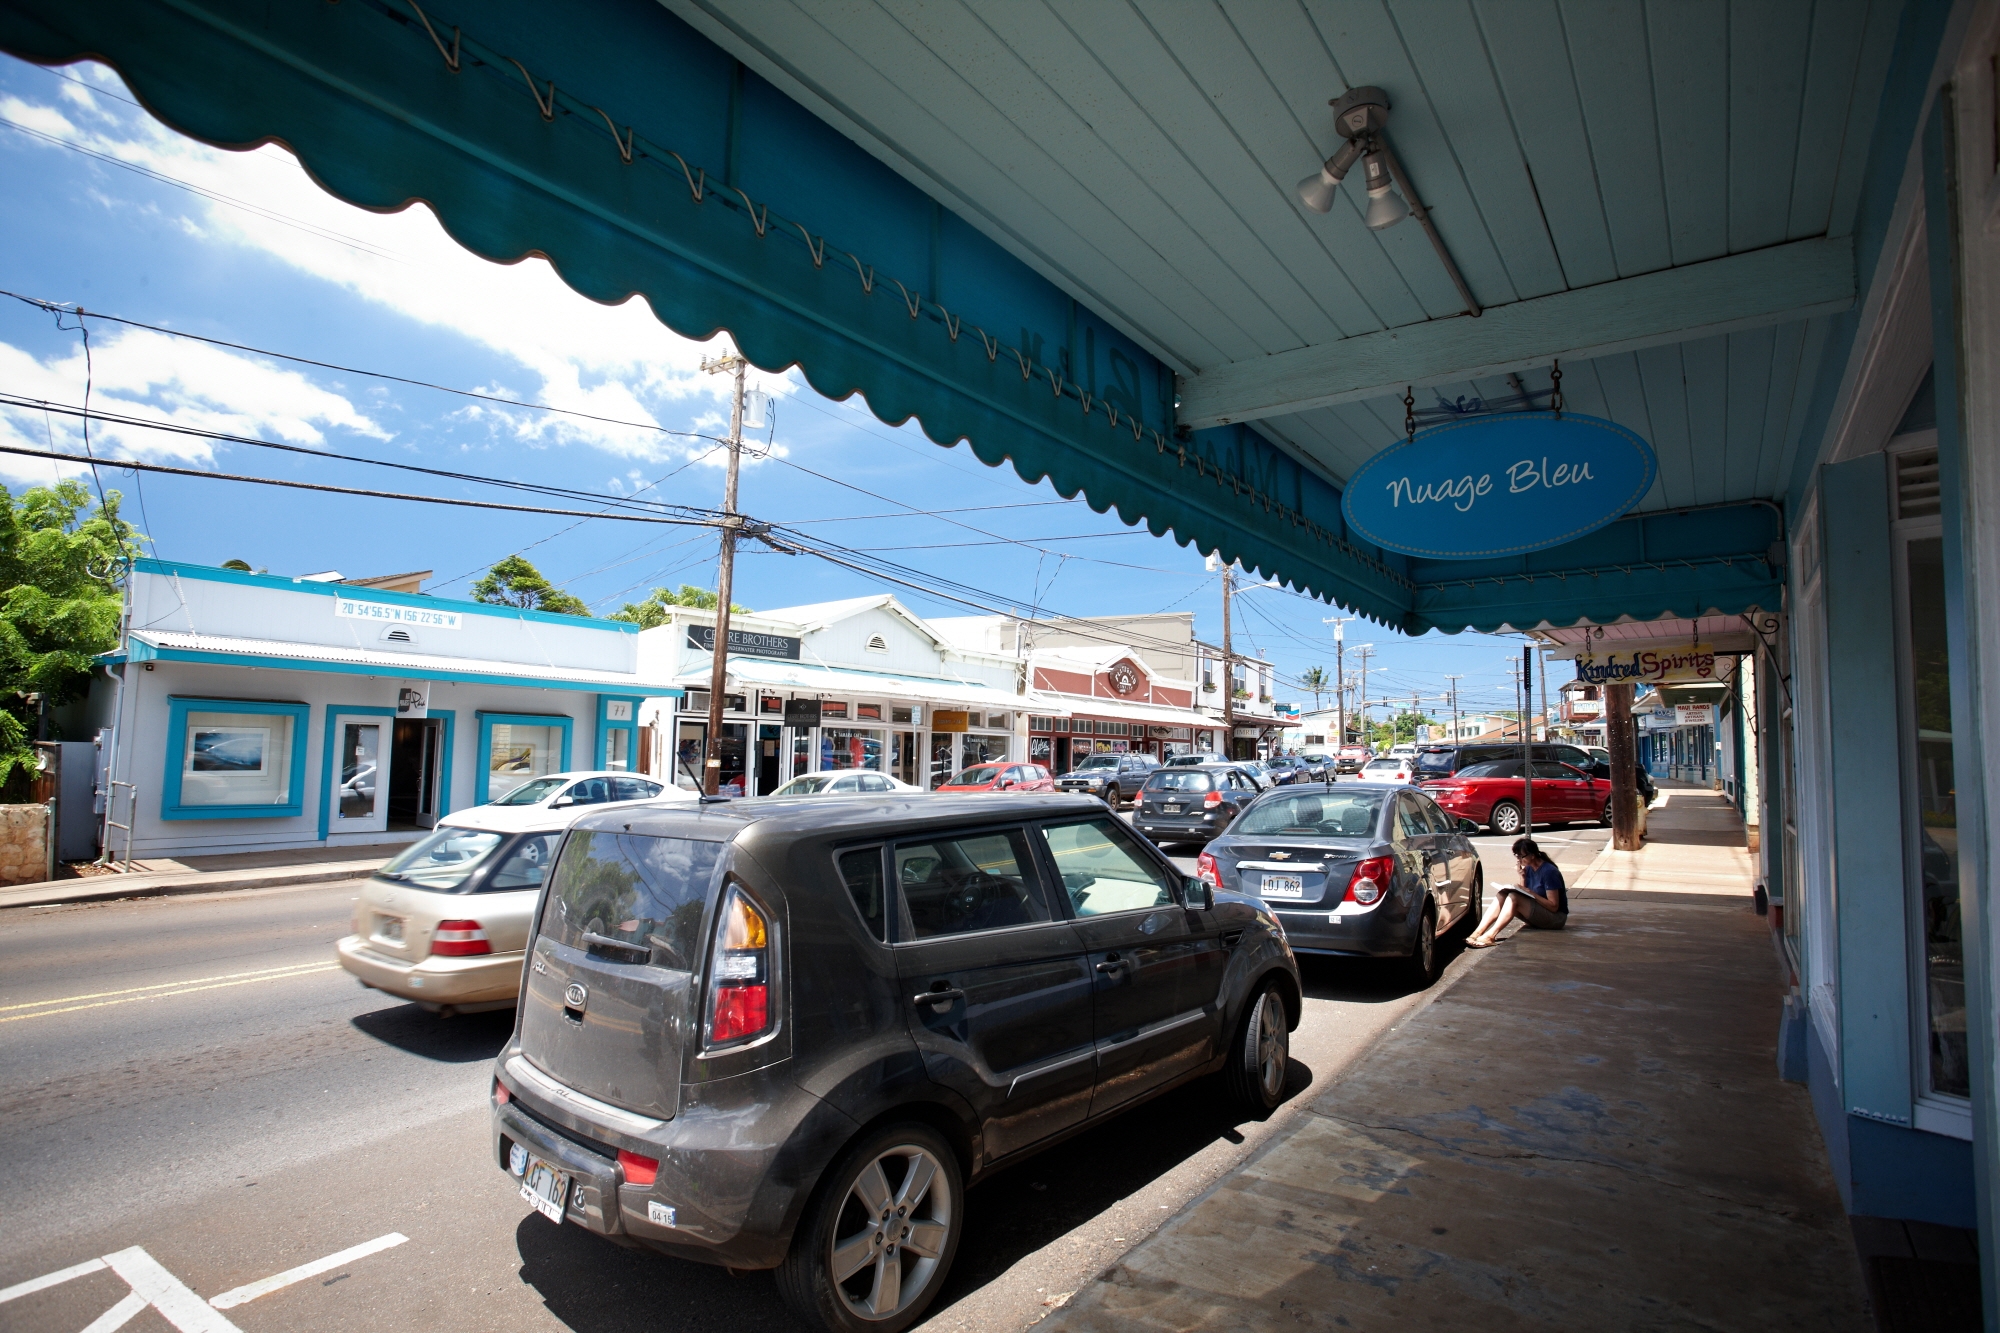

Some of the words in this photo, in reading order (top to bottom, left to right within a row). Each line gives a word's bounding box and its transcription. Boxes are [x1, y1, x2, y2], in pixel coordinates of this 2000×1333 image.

[1386, 473, 1493, 512] Nuage
[1505, 457, 1594, 493] Bleu
[703, 628, 740, 643] CERE
[742, 634, 789, 649] BROTHERS
[1575, 652, 1643, 684] Kindred
[1638, 651, 1715, 680] Spirits
[613, 704, 626, 716] 77
[1263, 879, 1279, 891] LDJ
[1284, 880, 1300, 892] 862
[568, 987, 582, 1002] KIA
[525, 1159, 546, 1191] LCF
[547, 1173, 567, 1209] 162
[652, 1210, 661, 1221] 04
[663, 1214, 672, 1225] 15
